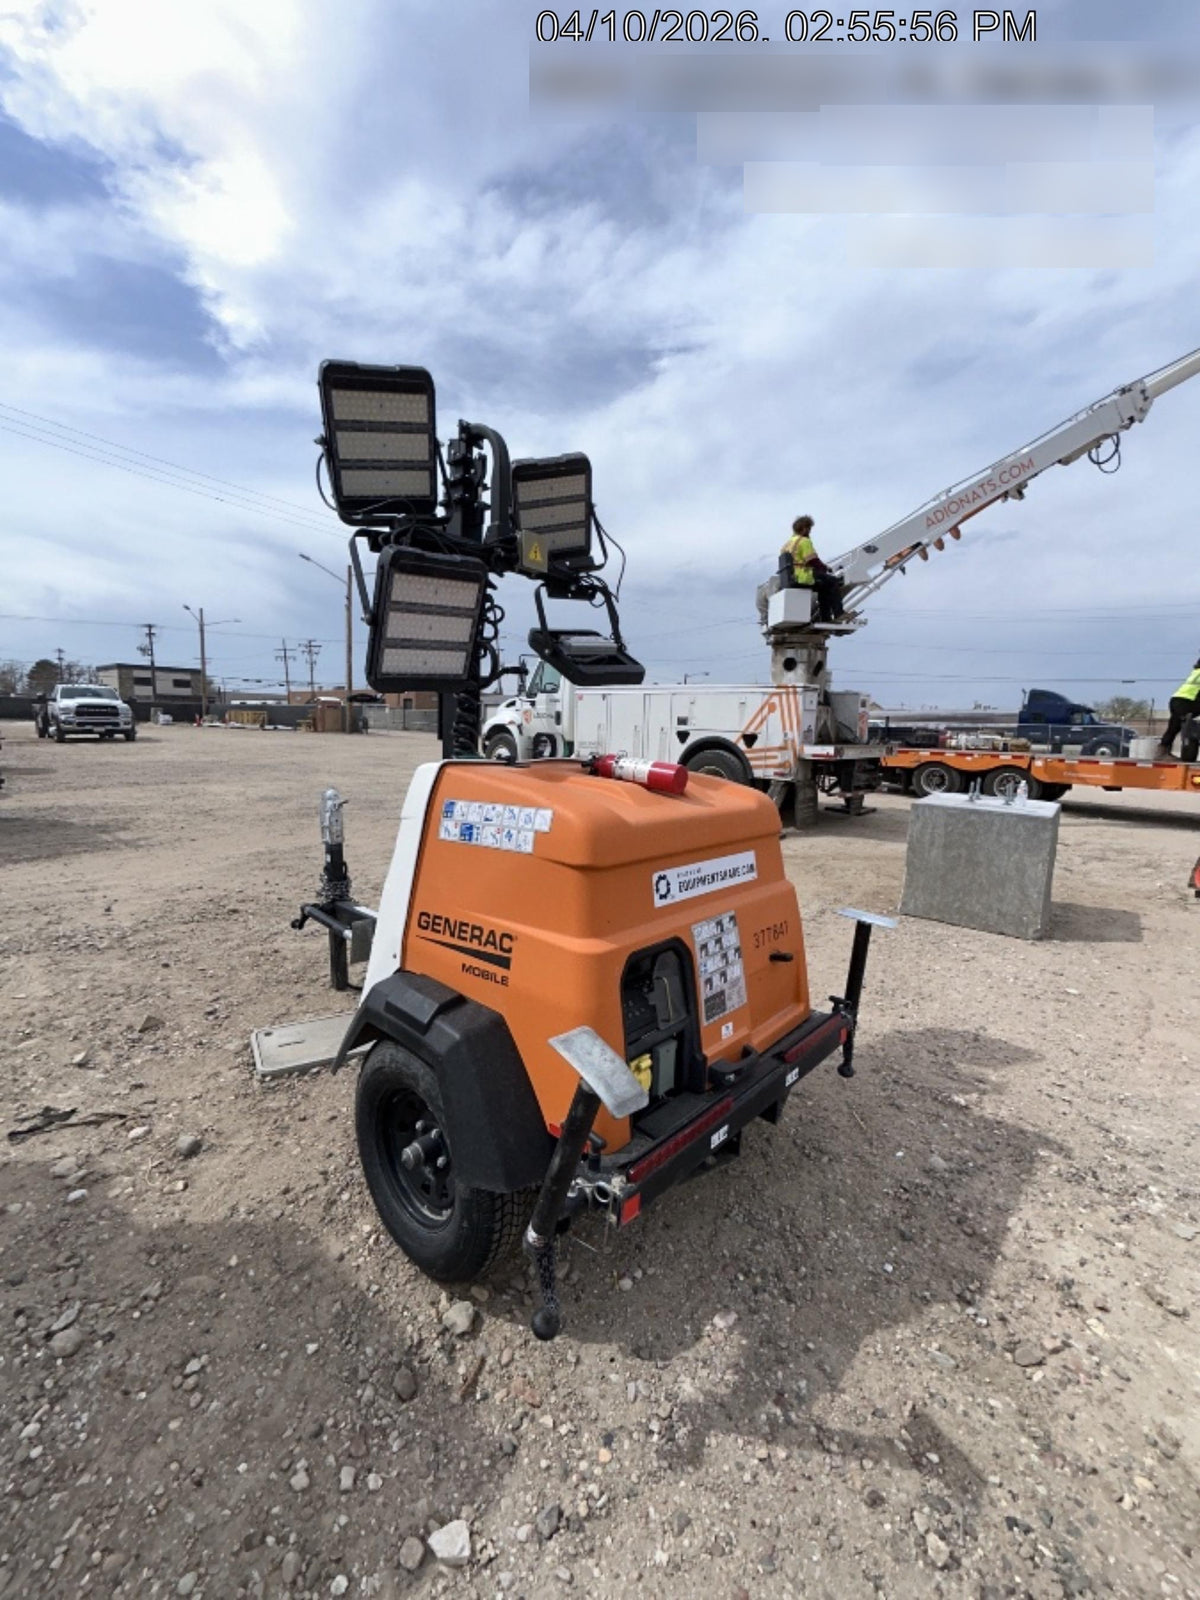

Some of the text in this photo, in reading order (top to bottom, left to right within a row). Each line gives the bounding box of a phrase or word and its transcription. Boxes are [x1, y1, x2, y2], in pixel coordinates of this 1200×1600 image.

[925, 458, 1036, 528] ADIONATS.COM
[417, 911, 514, 954] GENERAC
[461, 963, 510, 988] MOBILE
